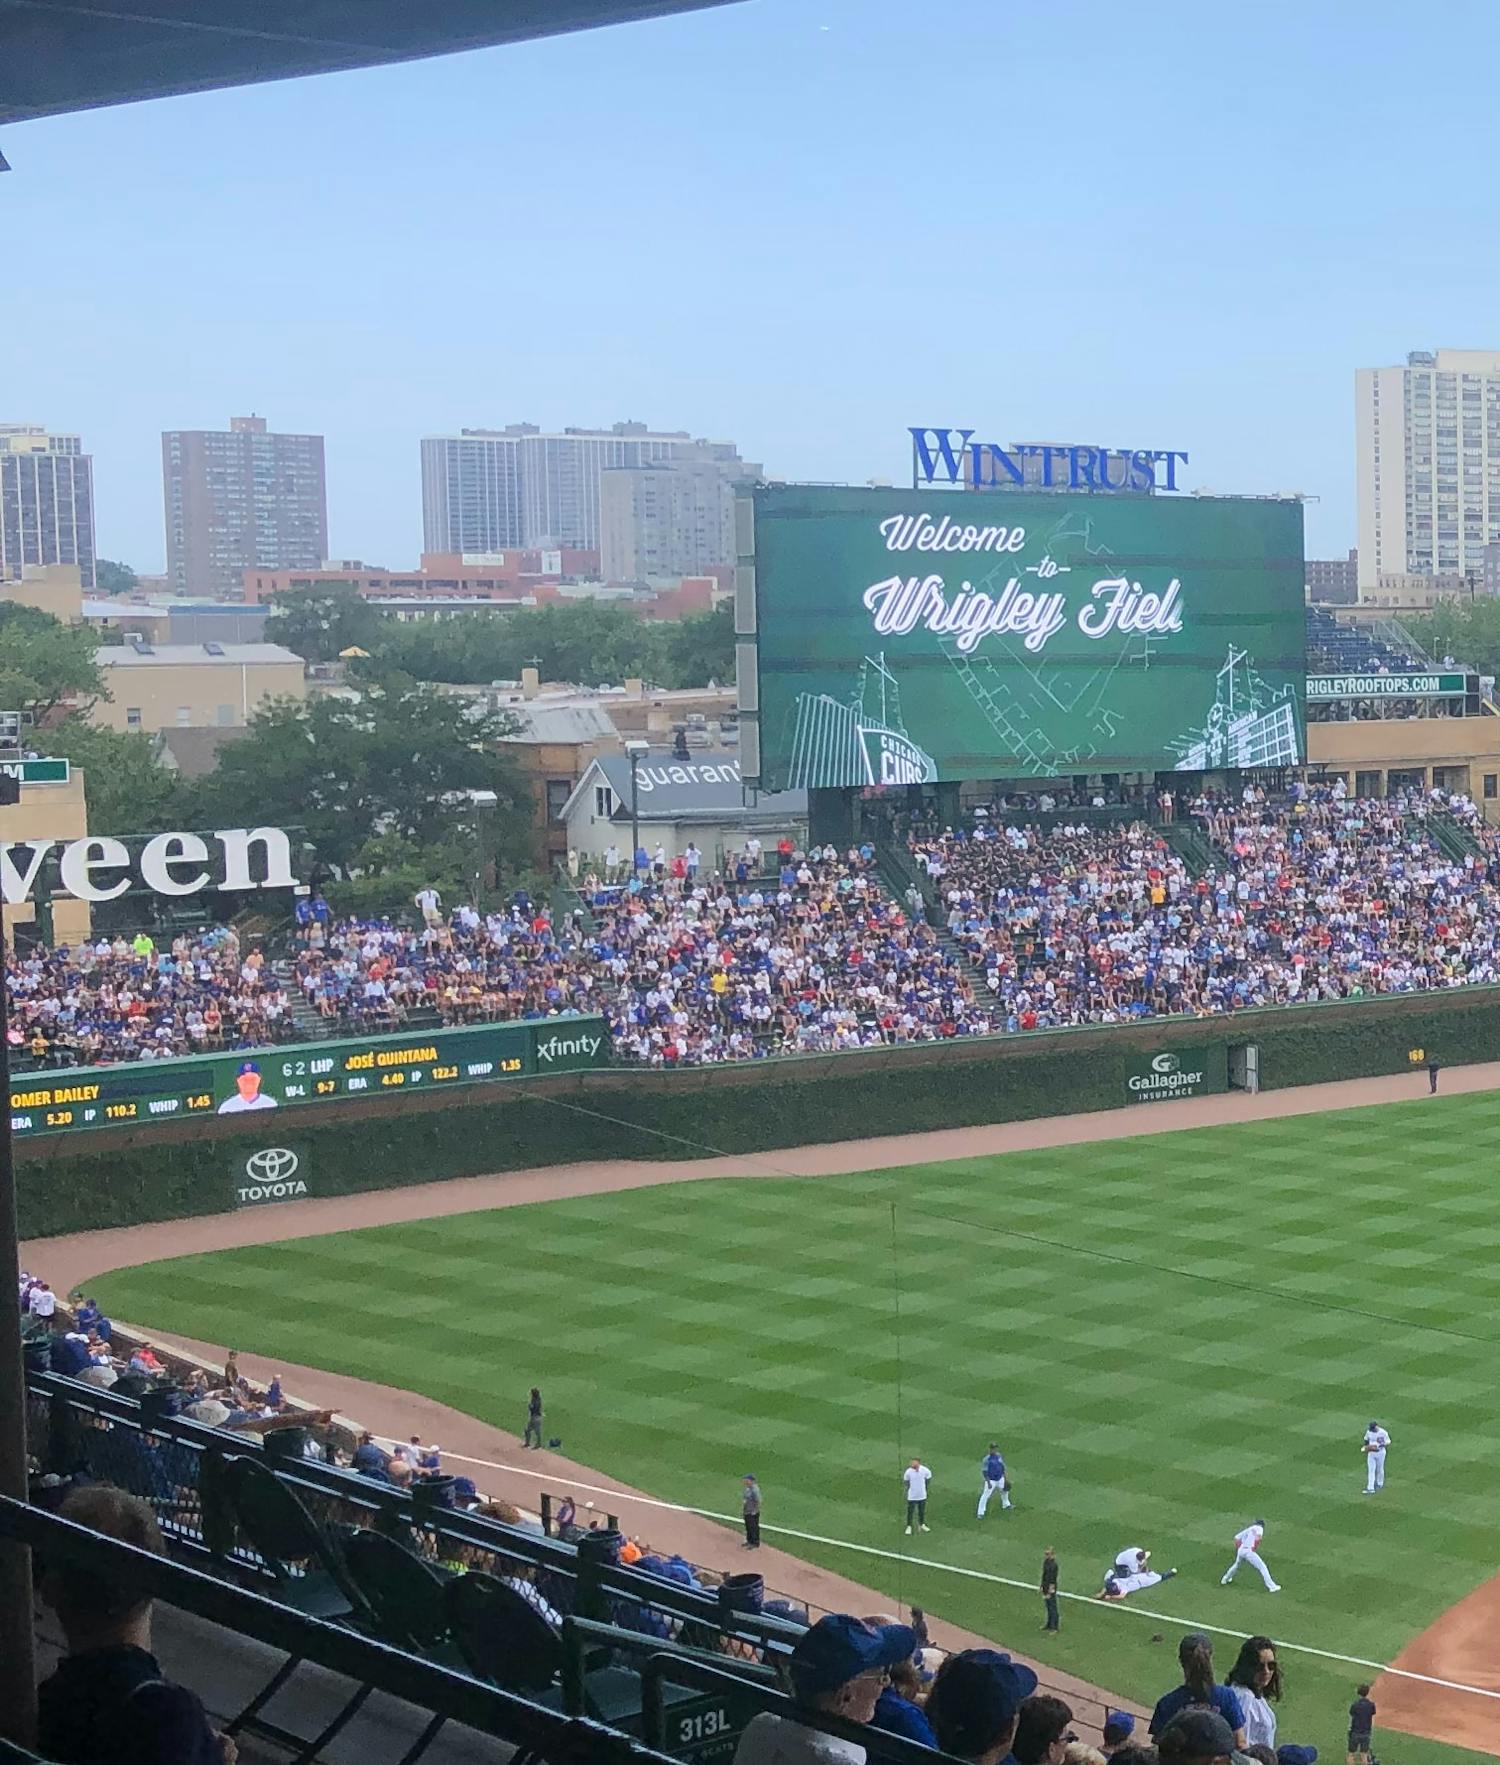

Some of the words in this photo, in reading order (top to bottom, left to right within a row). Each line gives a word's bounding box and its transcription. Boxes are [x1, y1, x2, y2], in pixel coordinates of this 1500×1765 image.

[908, 427, 1188, 492] WINTRUST
[879, 513, 1026, 552] Welcome
[863, 574, 1067, 655] Wrigley
[0, 827, 300, 903] veen
[345, 1052, 374, 1071] JOSÉ
[377, 1047, 438, 1068] QUINTANA
[536, 1036, 603, 1063] xfinity
[285, 1084, 306, 1097] W-L
[348, 1077, 367, 1090] ERA
[382, 1072, 404, 1086] 4.40
[411, 1070, 422, 1083] IP
[468, 1062, 493, 1076] WHIP
[500, 1058, 522, 1073] 1.35
[310, 1058, 334, 1075] LHP
[1128, 1071, 1203, 1090] Gallagher
[10, 1087, 52, 1109] OMER
[54, 1084, 100, 1104] BAILEY
[1138, 1087, 1193, 1101] INSURANCE
[11, 1116, 32, 1130] ERA
[47, 1111, 72, 1126] 5.20
[85, 1109, 96, 1121] IP
[105, 1104, 137, 1119] 110.2
[148, 1099, 178, 1113] WHIP
[186, 1095, 211, 1109] 1.45
[238, 1180, 307, 1201] TOYOTA
[680, 1708, 731, 1742] 313L
